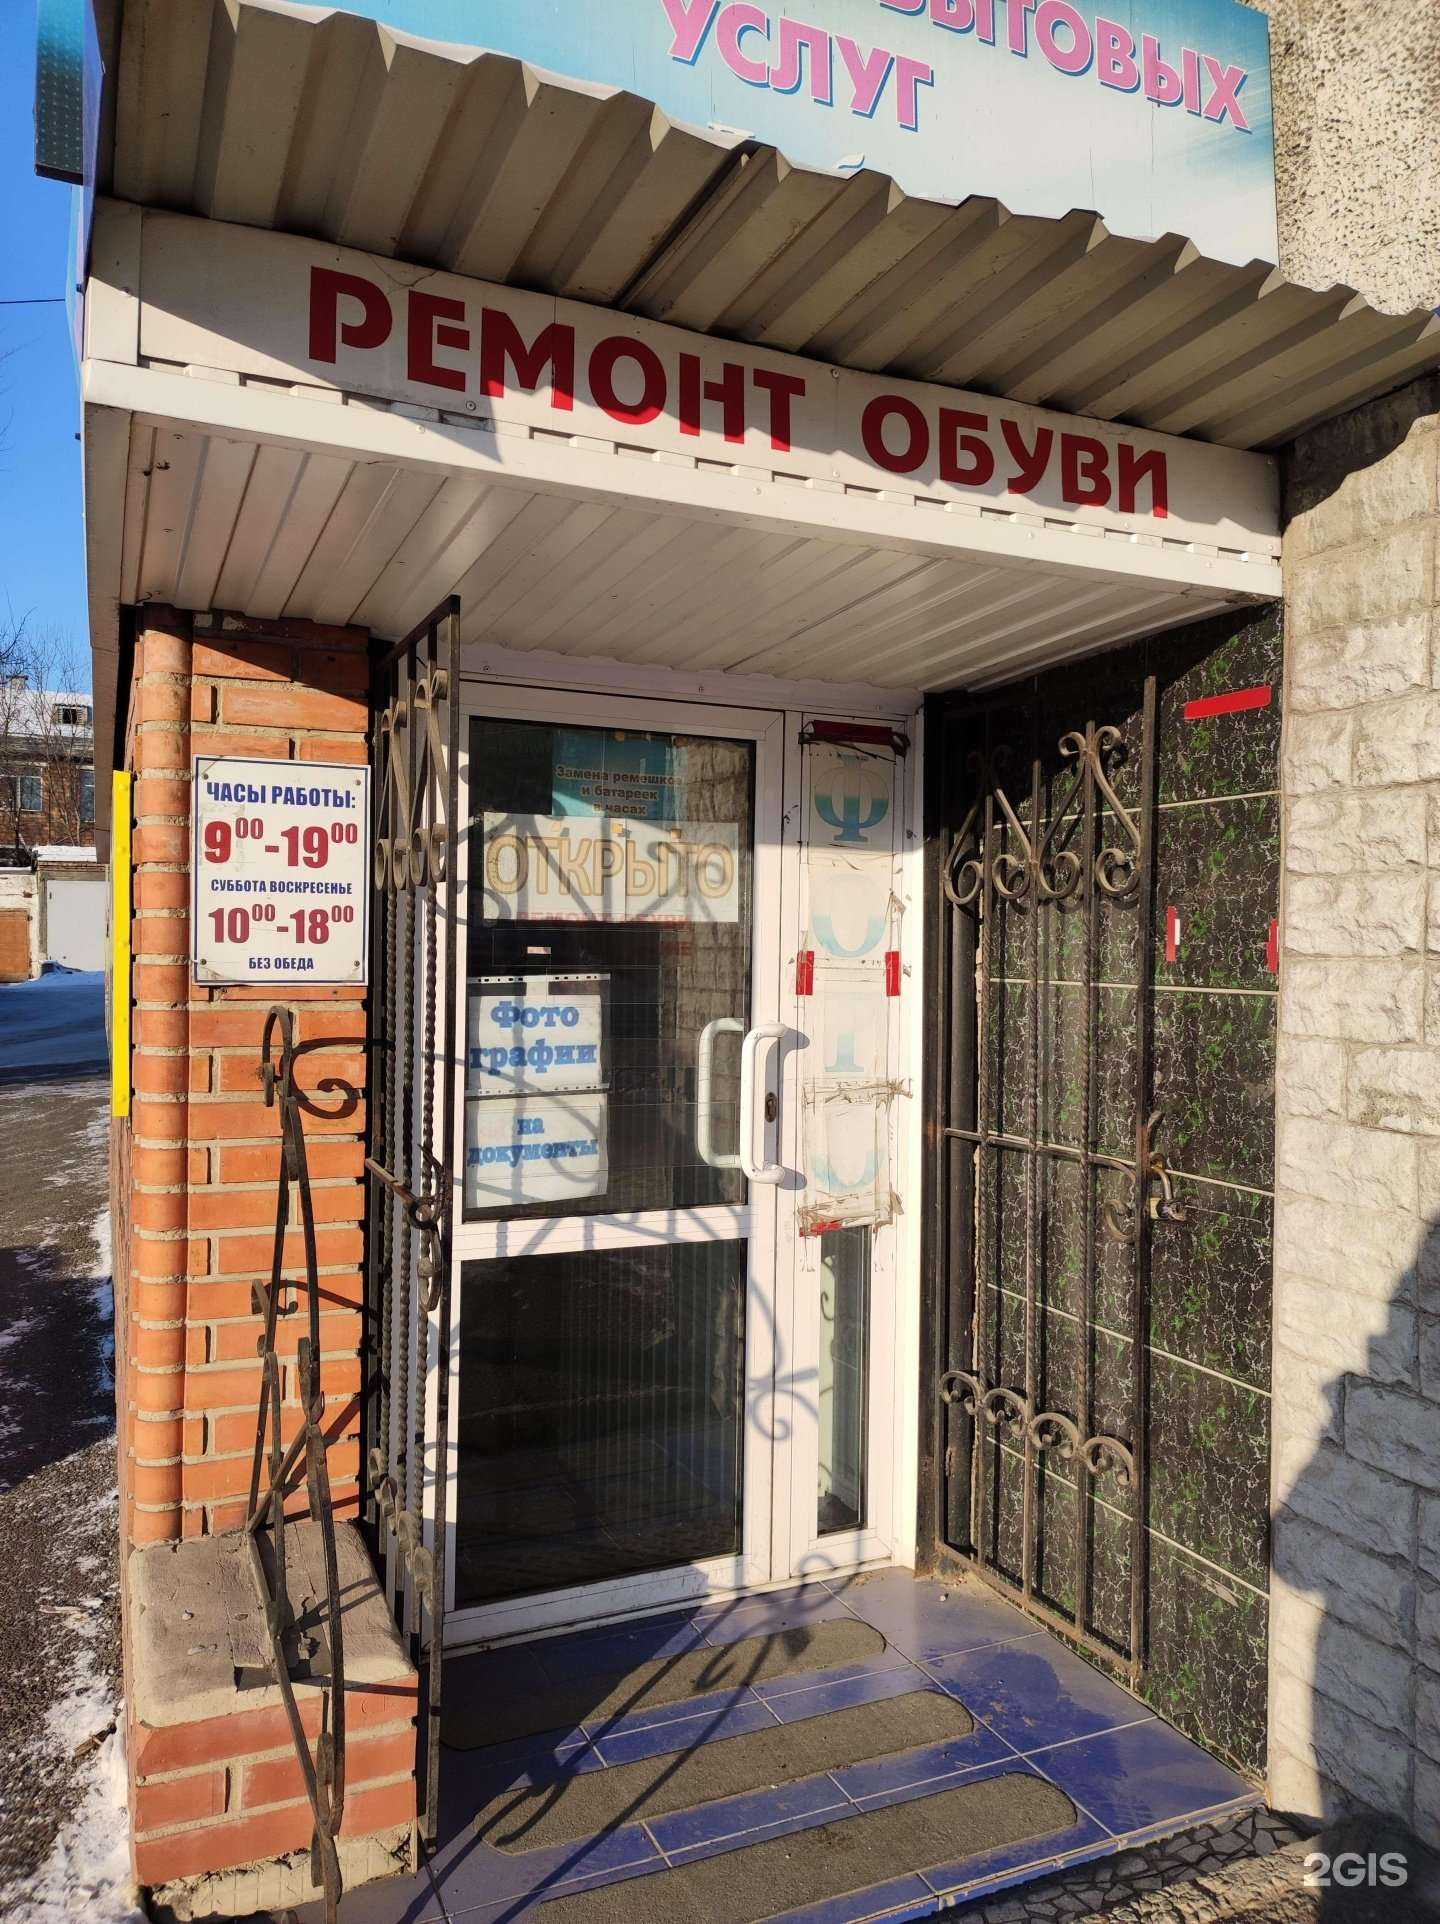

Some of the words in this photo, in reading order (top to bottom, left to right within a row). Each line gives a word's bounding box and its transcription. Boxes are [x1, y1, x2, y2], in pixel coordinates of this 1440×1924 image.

[662, 0, 935, 132] УСЛУГ
[871, 0, 1253, 134] ЫТОВЫХ
[308, 265, 806, 452] РЕМОНТ
[860, 393, 1169, 519] ОБУВИ
[557, 765, 608, 781] Замена
[206, 781, 266, 804] ЧАСЫ
[271, 785, 357, 809] РАБОТЫ:
[581, 785, 591, 796] и
[485, 833, 735, 898] ОТКРЫТО
[210, 878, 267, 893] СУББОТА
[269, 880, 353, 895] ВОСКРЕСЕНЬЕ
[248, 957, 271, 970] БЕЗ
[274, 957, 315, 971] ОБЕДА
[469, 1038, 598, 1074] графии
[517, 1117, 545, 1136] на
[467, 1139, 598, 1168] документы
